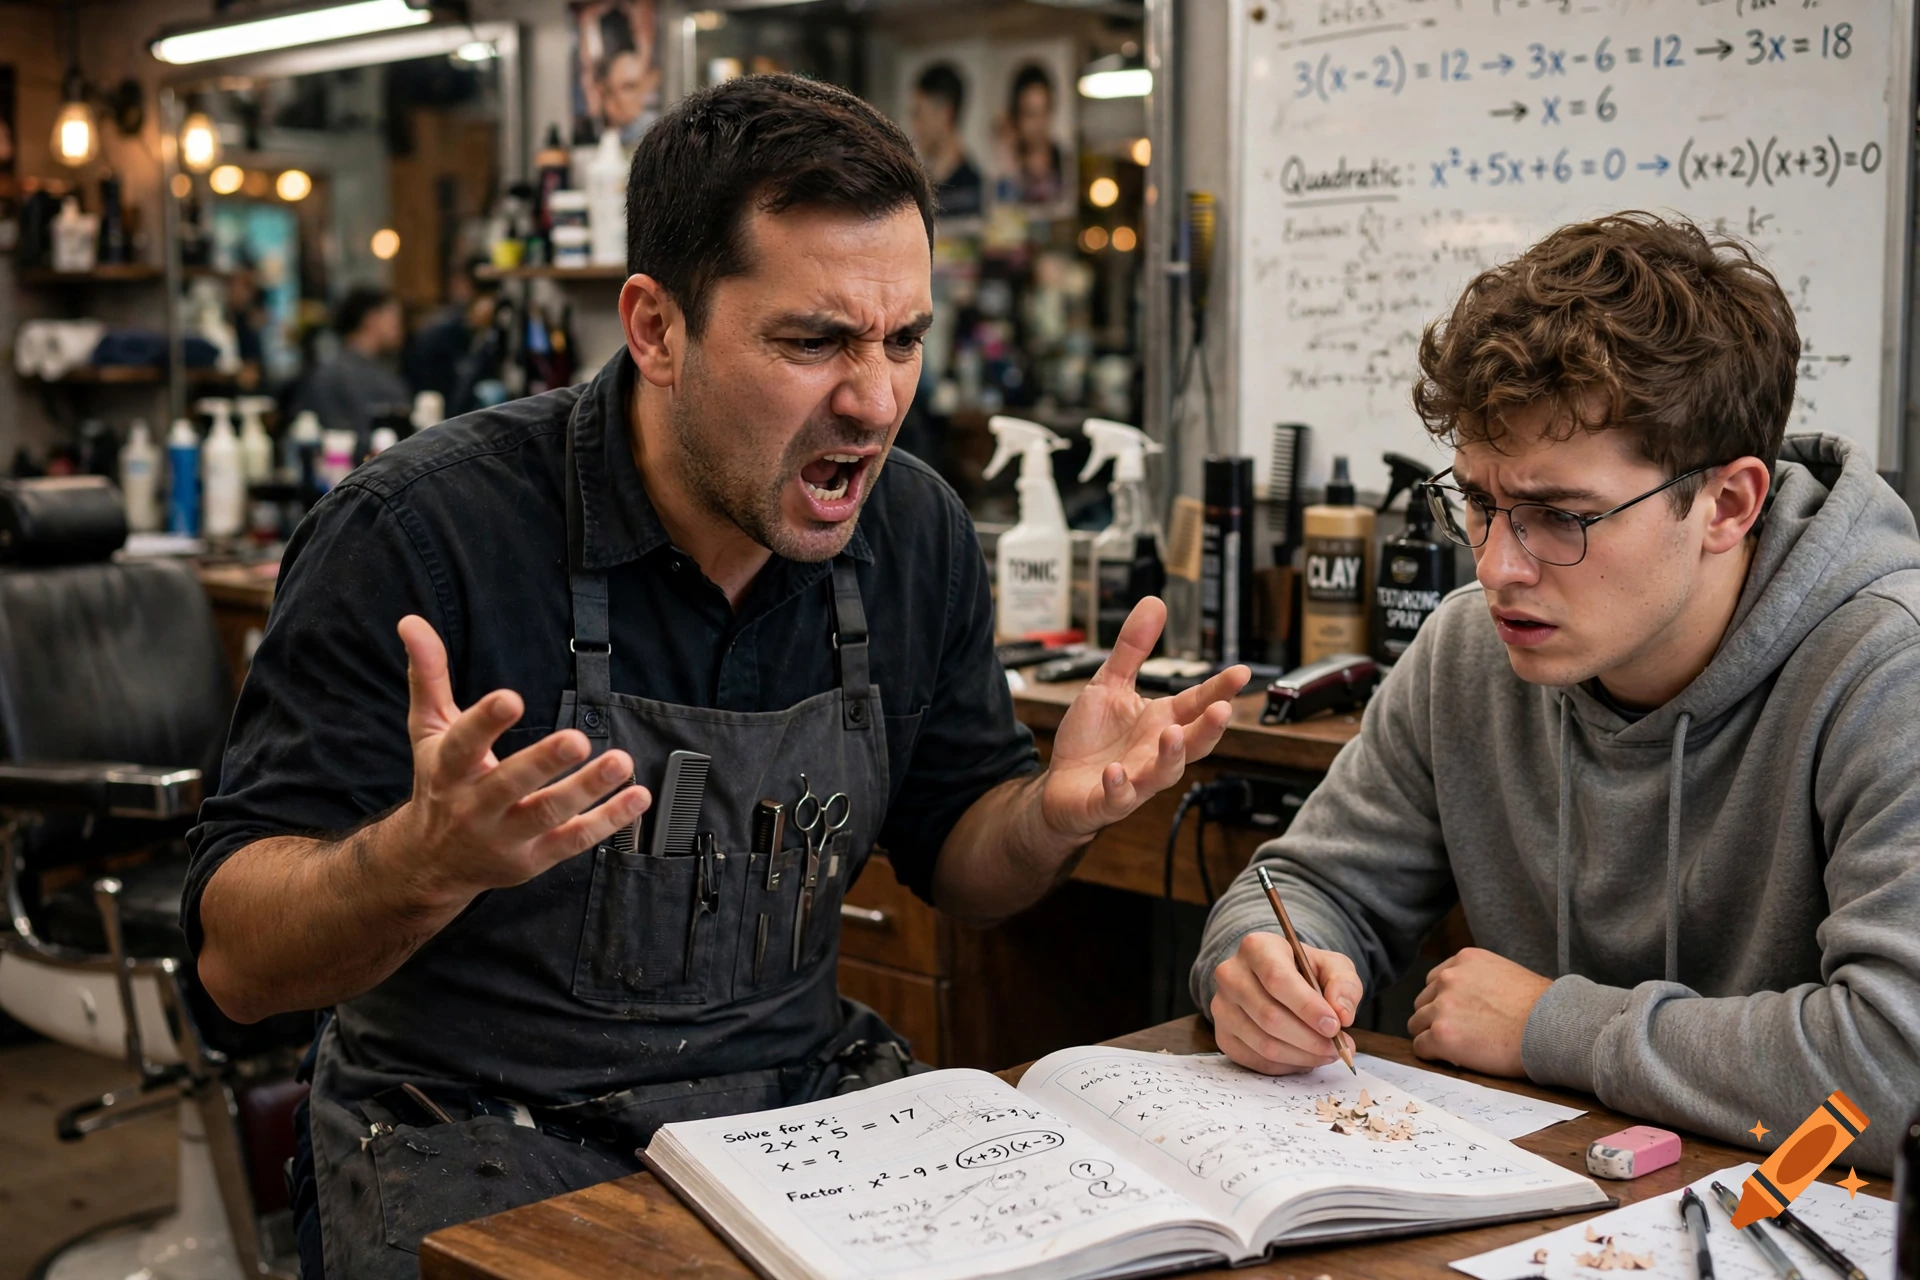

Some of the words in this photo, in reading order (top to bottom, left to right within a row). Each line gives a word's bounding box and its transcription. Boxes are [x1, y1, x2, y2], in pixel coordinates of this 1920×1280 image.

[1440, 49, 1472, 82] 12
[1653, 33, 1686, 68] 12
[1821, 22, 1854, 60] 18
[1540, 95, 1561, 126] x
[1595, 84, 1619, 123] 6
[1280, 154, 1416, 196] Quadratic:
[1007, 557, 1059, 583] TONIC
[1307, 554, 1361, 589] CLAY
[1386, 608, 1423, 630] SPRAY
[723, 1129, 772, 1144] Solve
[779, 1122, 806, 1136] for
[814, 1116, 838, 1129] x:
[760, 1139, 798, 1154] 2x
[807, 1134, 823, 1144] +
[830, 1126, 849, 1140] 5
[861, 1122, 878, 1131] =
[889, 1107, 915, 1125] 17
[776, 1161, 795, 1173] x
[801, 1158, 818, 1167] =
[827, 1149, 843, 1164] ?
[785, 1184, 855, 1203] Factor:
[913, 1166, 927, 1178] 9
